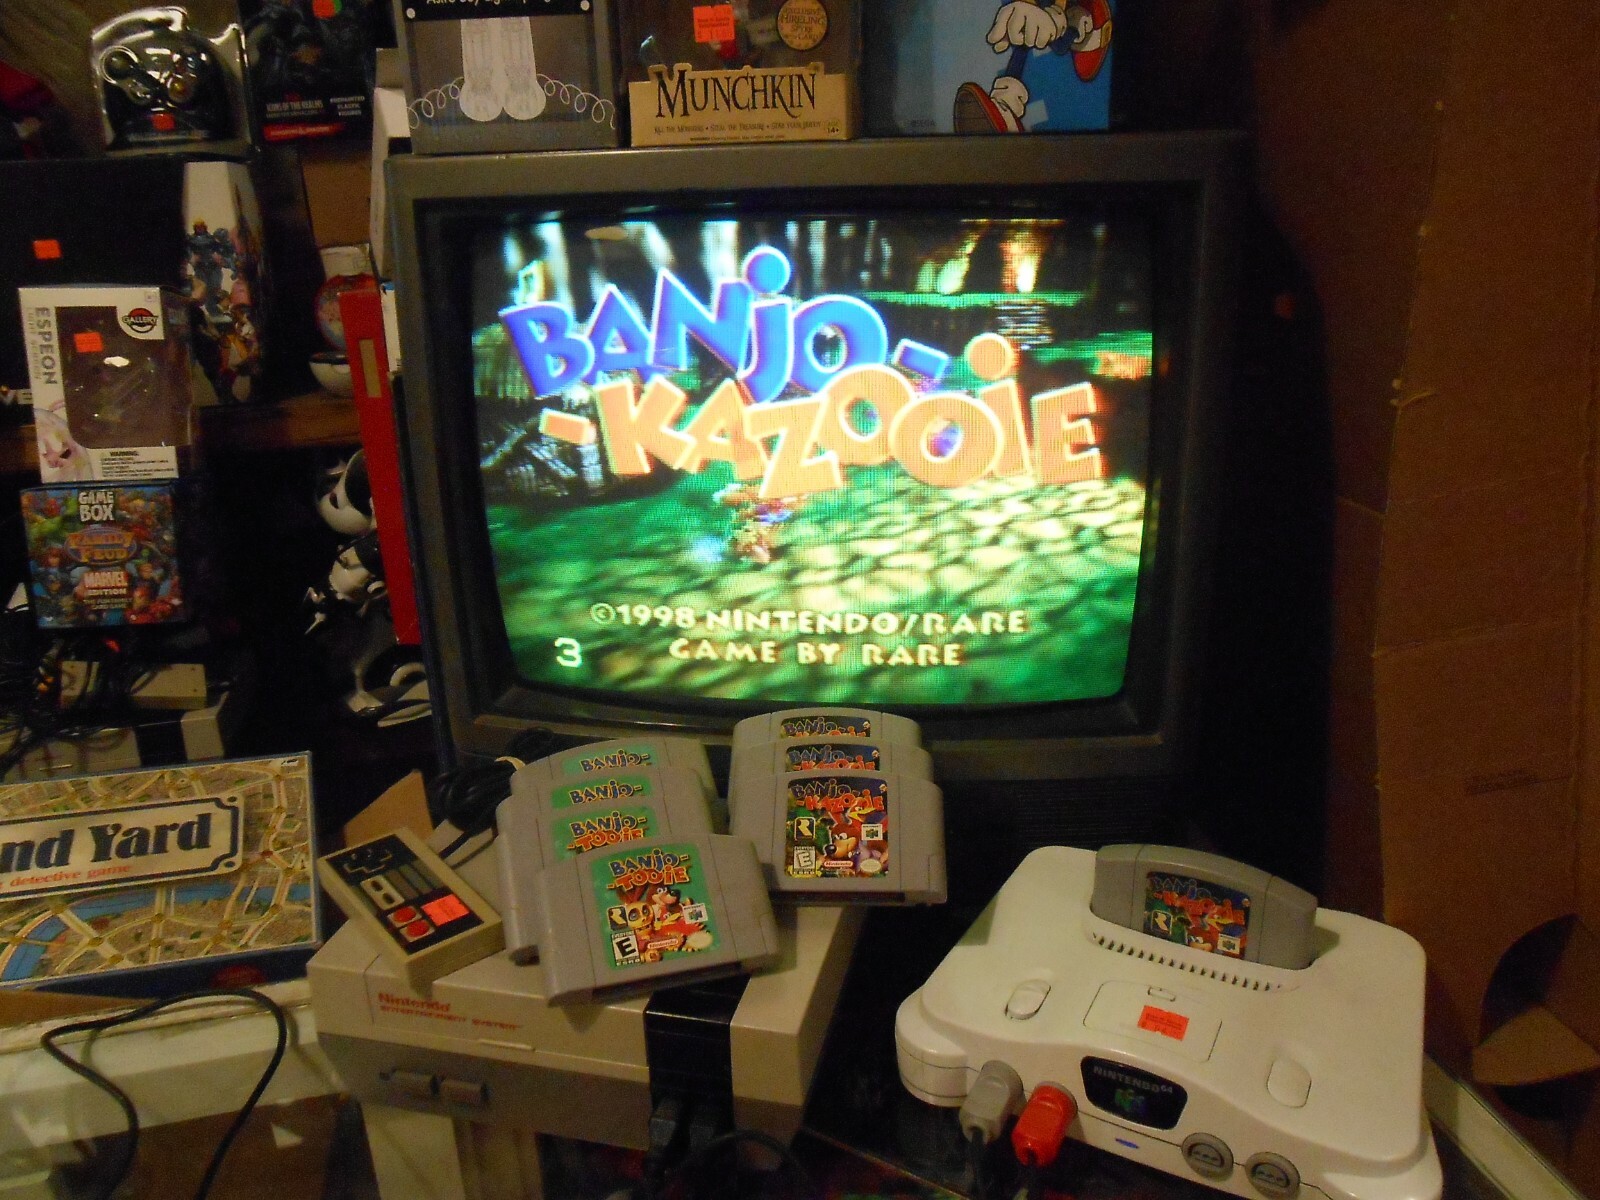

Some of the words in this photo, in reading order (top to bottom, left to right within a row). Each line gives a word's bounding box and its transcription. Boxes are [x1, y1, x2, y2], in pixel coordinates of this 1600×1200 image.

[655, 69, 817, 118] MUNCHKIN
[34, 306, 58, 385] ESPEON
[78, 491, 114, 505] GAME
[79, 504, 115, 522] BOX
[84, 571, 128, 587] MARVEL
[589, 602, 697, 629] ©1998
[704, 608, 1028, 635] NINTENDO/RARE
[553, 636, 583, 668] 3
[668, 637, 778, 665] GAME
[797, 642, 841, 666] BY
[862, 642, 963, 667] RARE
[0, 829, 75, 873] nd
[87, 812, 213, 864] Yard
[796, 850, 812, 868] E
[9, 869, 82, 888] detective
[87, 863, 132, 880] game
[615, 937, 637, 958] E
[378, 992, 450, 1012] Nintendo
[1092, 1064, 1161, 1094] NINTENDO
[1160, 1082, 1174, 1095] 64
